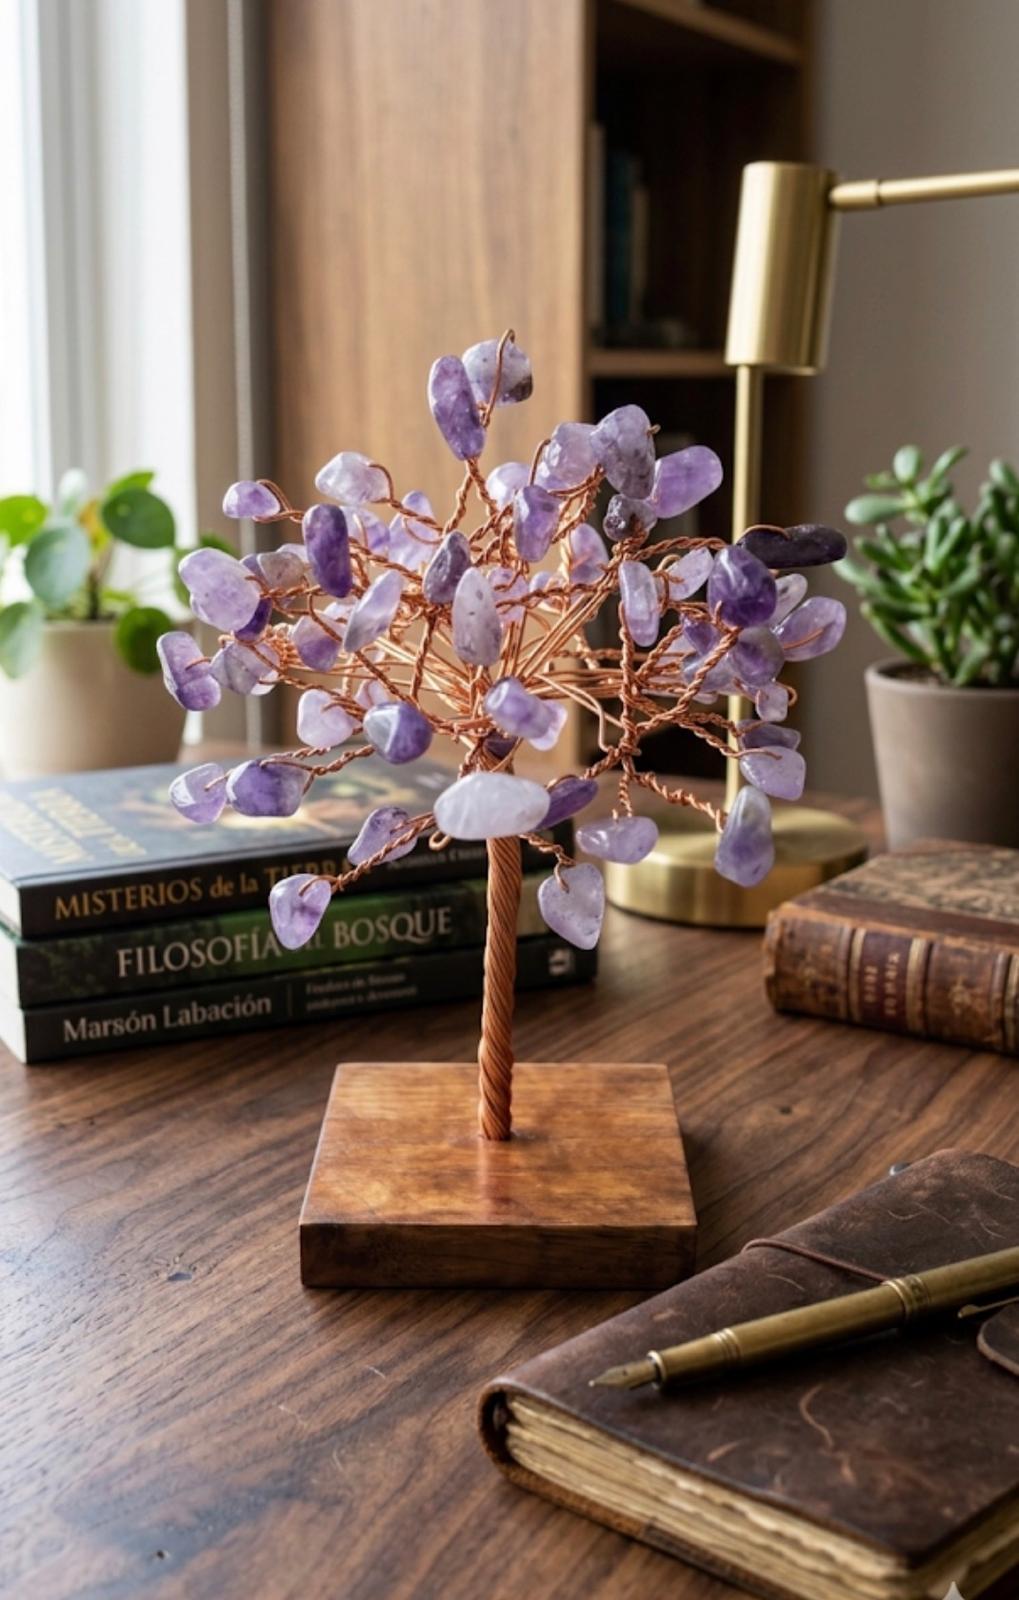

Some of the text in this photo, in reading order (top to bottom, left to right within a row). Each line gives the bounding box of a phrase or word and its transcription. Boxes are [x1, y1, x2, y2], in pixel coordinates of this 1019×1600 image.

[55, 877, 203, 920] MISTERIOS
[209, 875, 234, 898] de
[240, 873, 259, 893] la
[116, 926, 282, 977] FILOSOFÍA
[333, 907, 452, 951] BOSQUE
[63, 1010, 156, 1043] Marsón
[163, 993, 272, 1029] Labación
